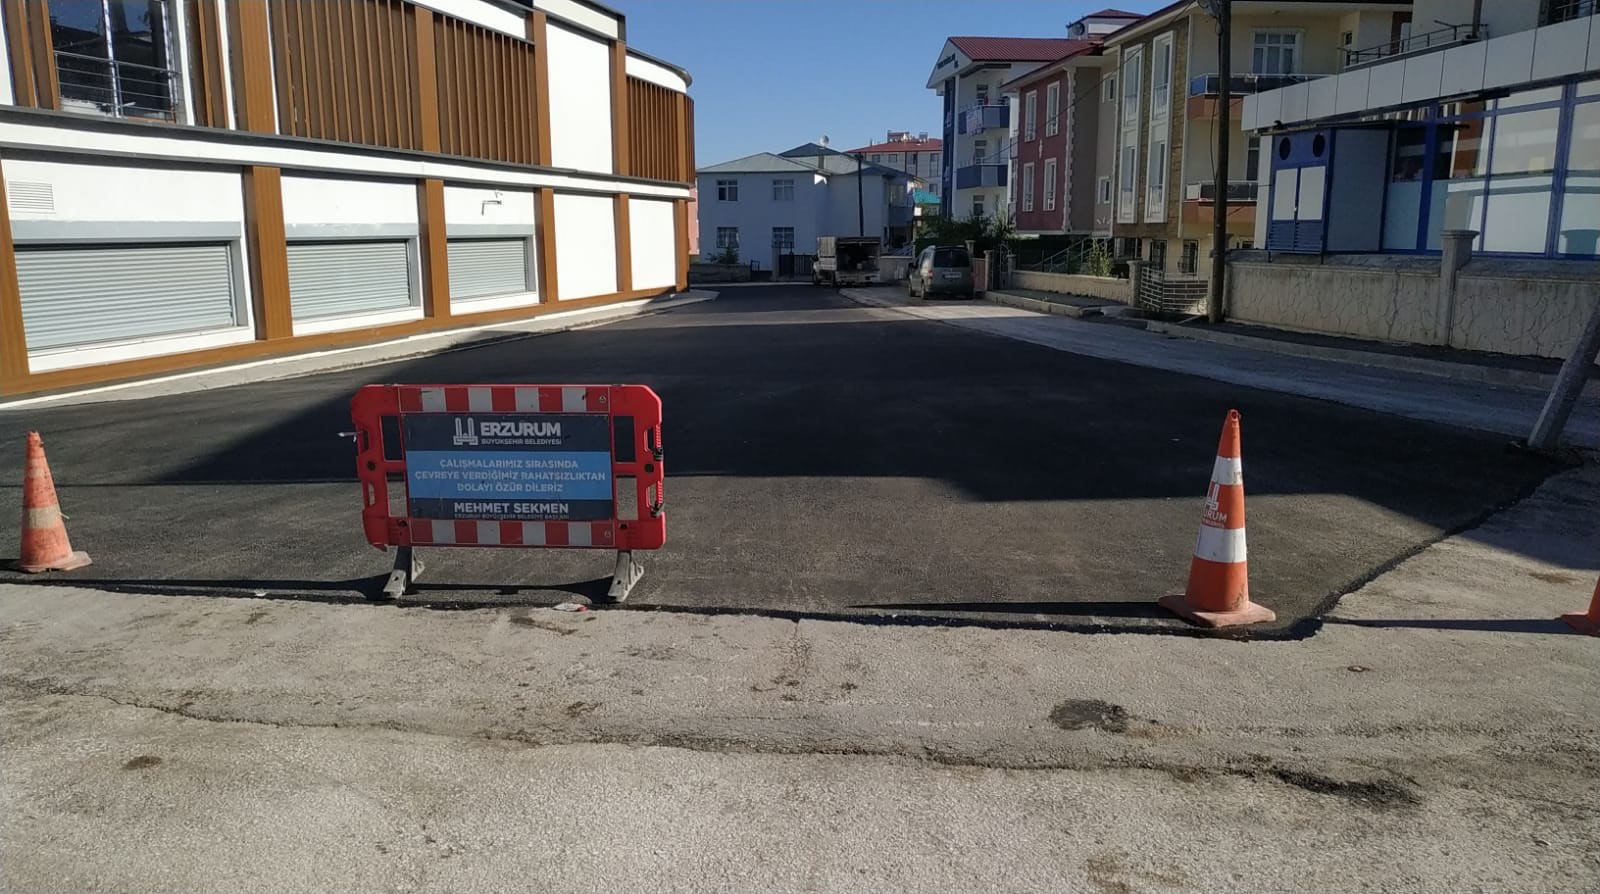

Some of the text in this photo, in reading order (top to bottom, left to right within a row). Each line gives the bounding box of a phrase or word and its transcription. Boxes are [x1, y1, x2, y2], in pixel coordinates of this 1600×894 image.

[480, 422, 561, 436] ERZURUM
[440, 459, 579, 470] ÇALIŞMALARIMIZ SIRASINDA
[415, 470, 606, 481] ÇEVREYE VERDİĞİMİZ RAHATSIZLIKTAN
[457, 482, 563, 492] DOLAYI ÖZÜR DİLERİZ
[454, 502, 569, 514] MEHMET SEKMEN
